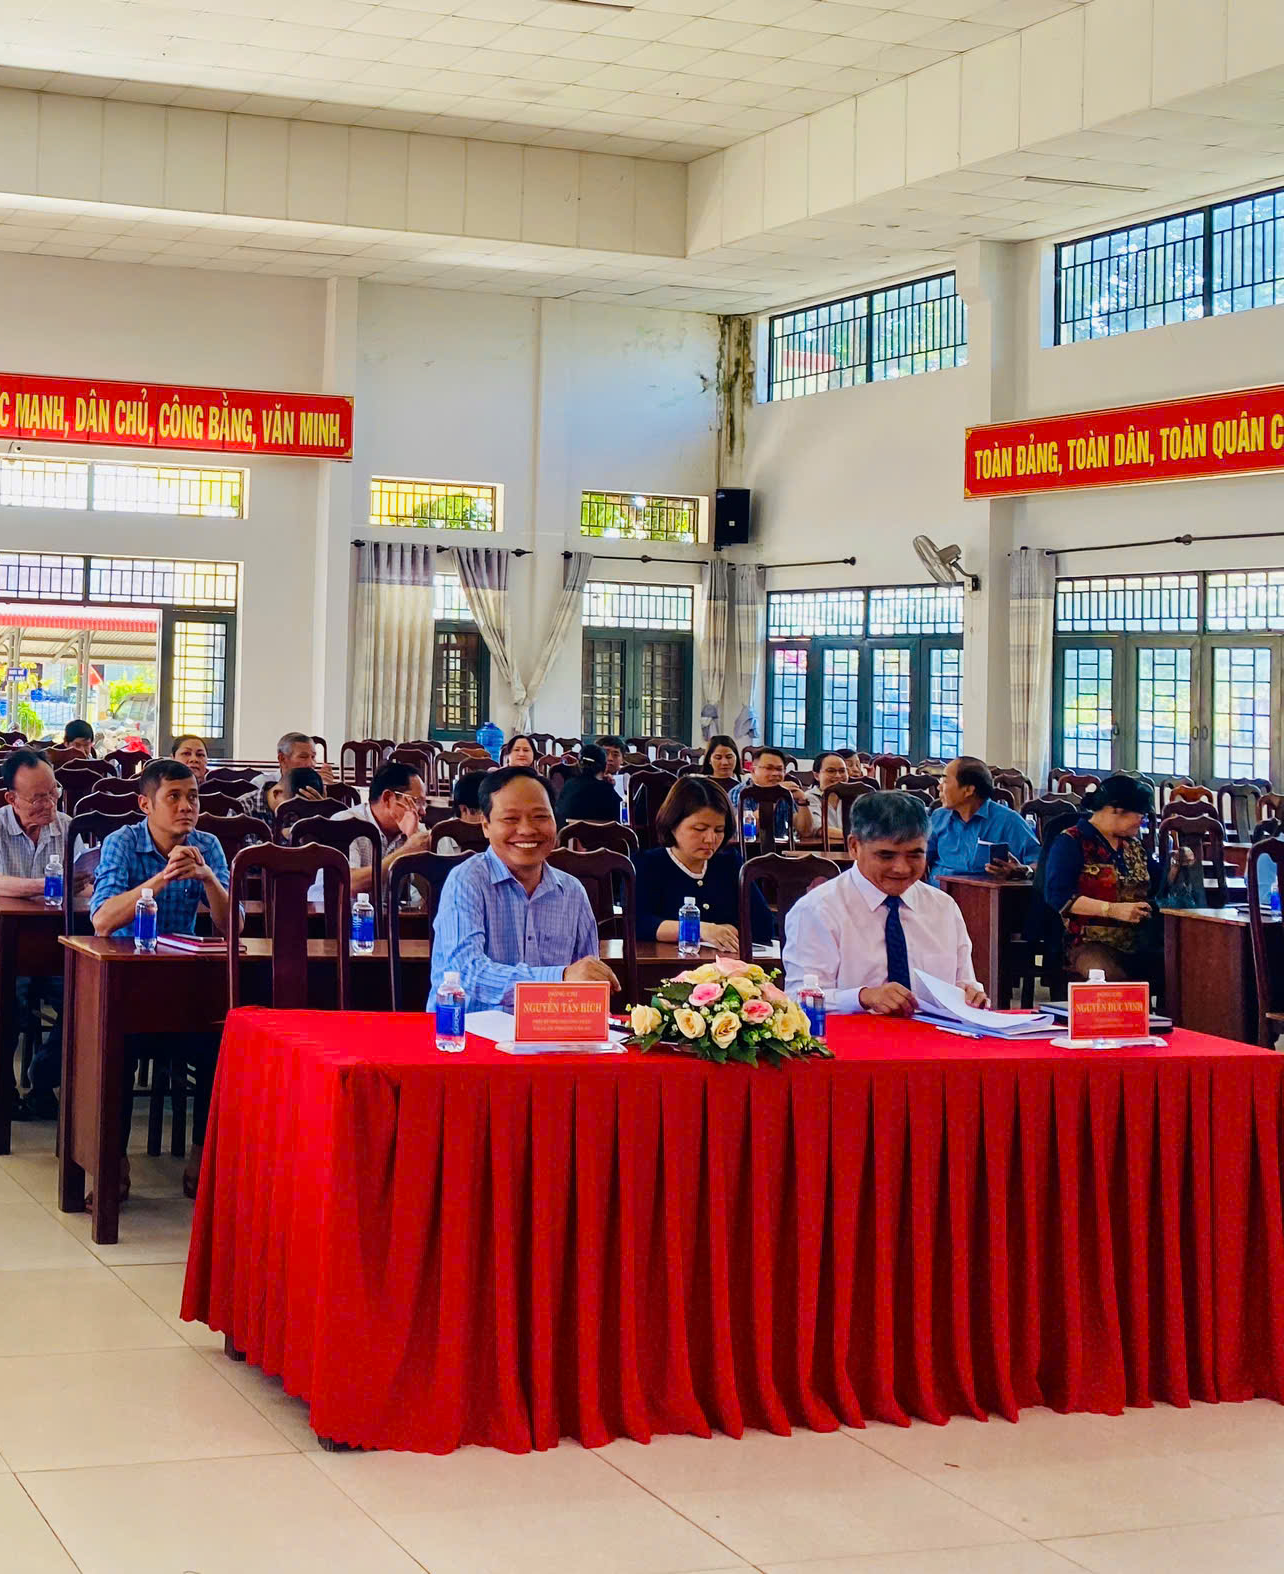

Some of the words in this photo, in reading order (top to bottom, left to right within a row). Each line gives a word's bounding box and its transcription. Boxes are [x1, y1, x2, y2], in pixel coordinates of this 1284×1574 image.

[15, 392, 69, 437] MẠNH,
[75, 388, 110, 434] DÂN
[114, 387, 154, 443] CHỦ,
[159, 394, 203, 440] CÔNG
[208, 391, 257, 450] BẰNG,
[262, 402, 295, 445] VĂN
[299, 411, 345, 448] MINH.
[974, 441, 1012, 480] TOÀN
[1015, 433, 1063, 477] ĐẢNG,
[1067, 430, 1109, 471] TOÀN
[1114, 424, 1155, 467] DÂN,
[1159, 418, 1207, 461] TOÀN
[1212, 410, 1265, 459] QUÂN
